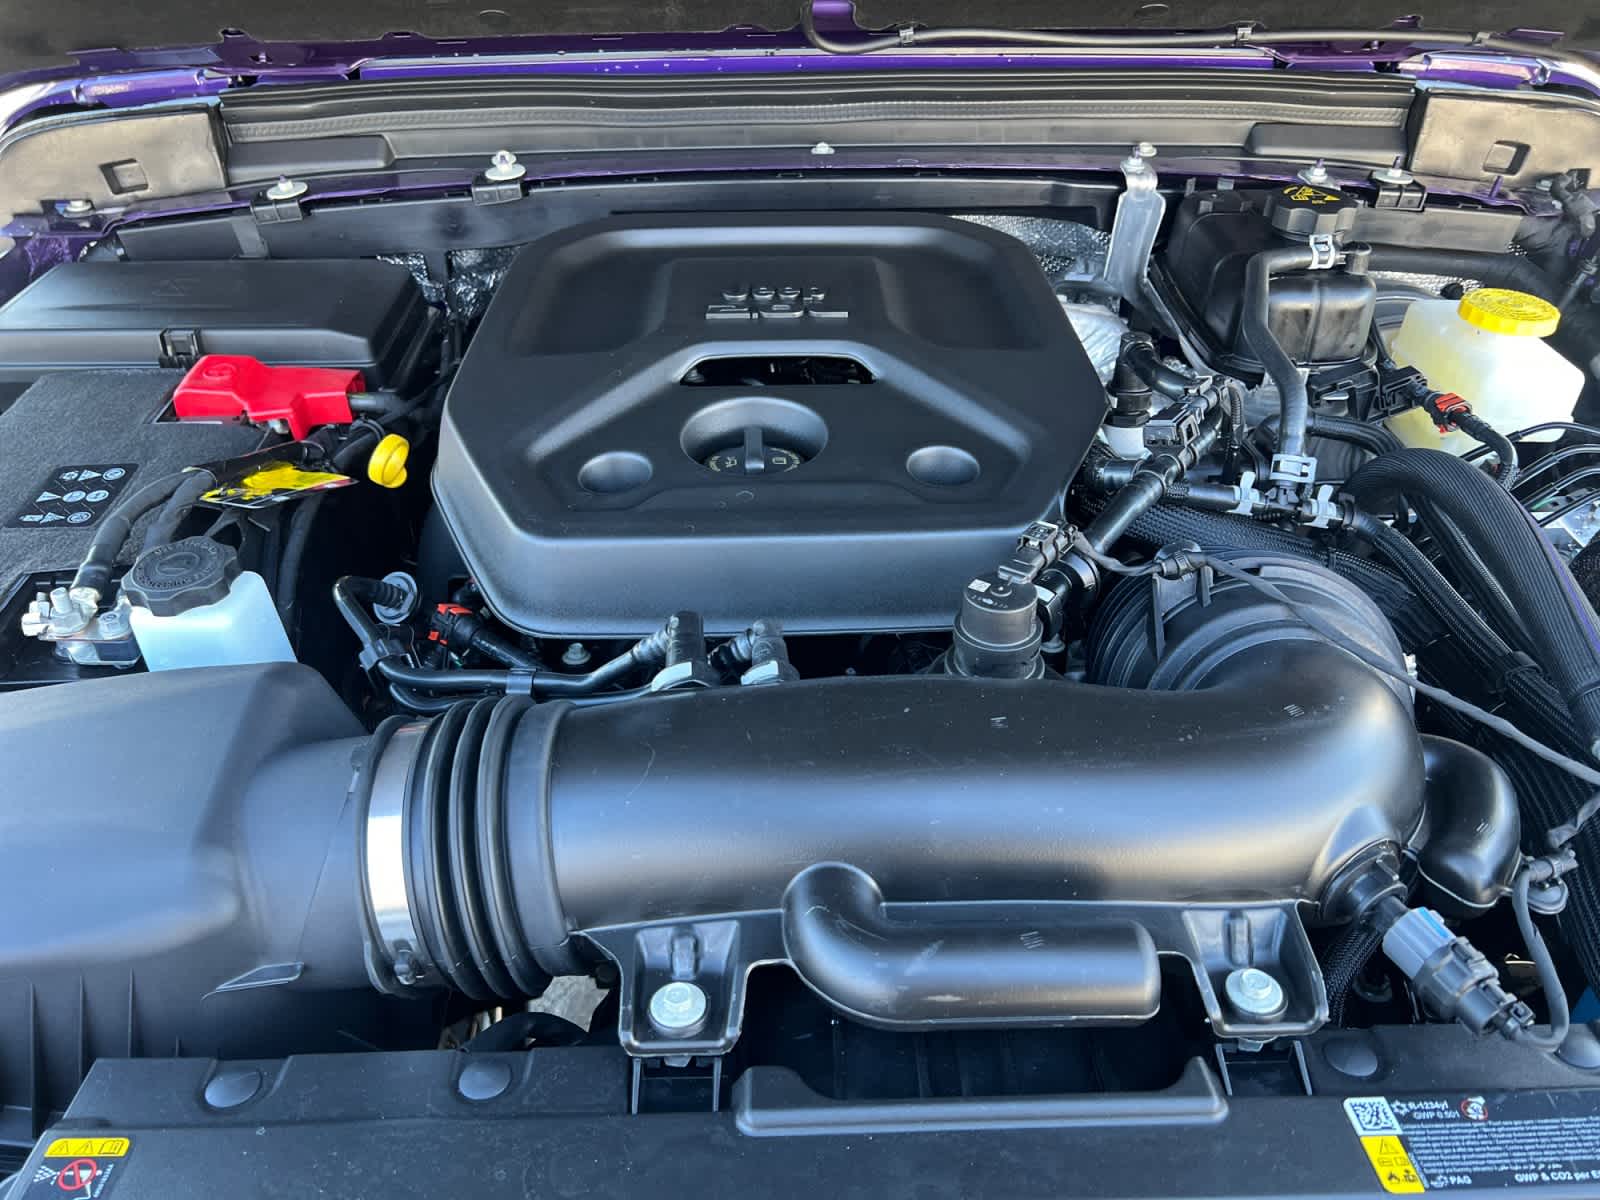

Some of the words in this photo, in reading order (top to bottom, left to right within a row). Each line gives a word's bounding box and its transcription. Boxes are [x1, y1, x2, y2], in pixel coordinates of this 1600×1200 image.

[1515, 1172, 1539, 1183] GWP
[1541, 1172, 1550, 1181] &
[1550, 1171, 1574, 1181] CO2
